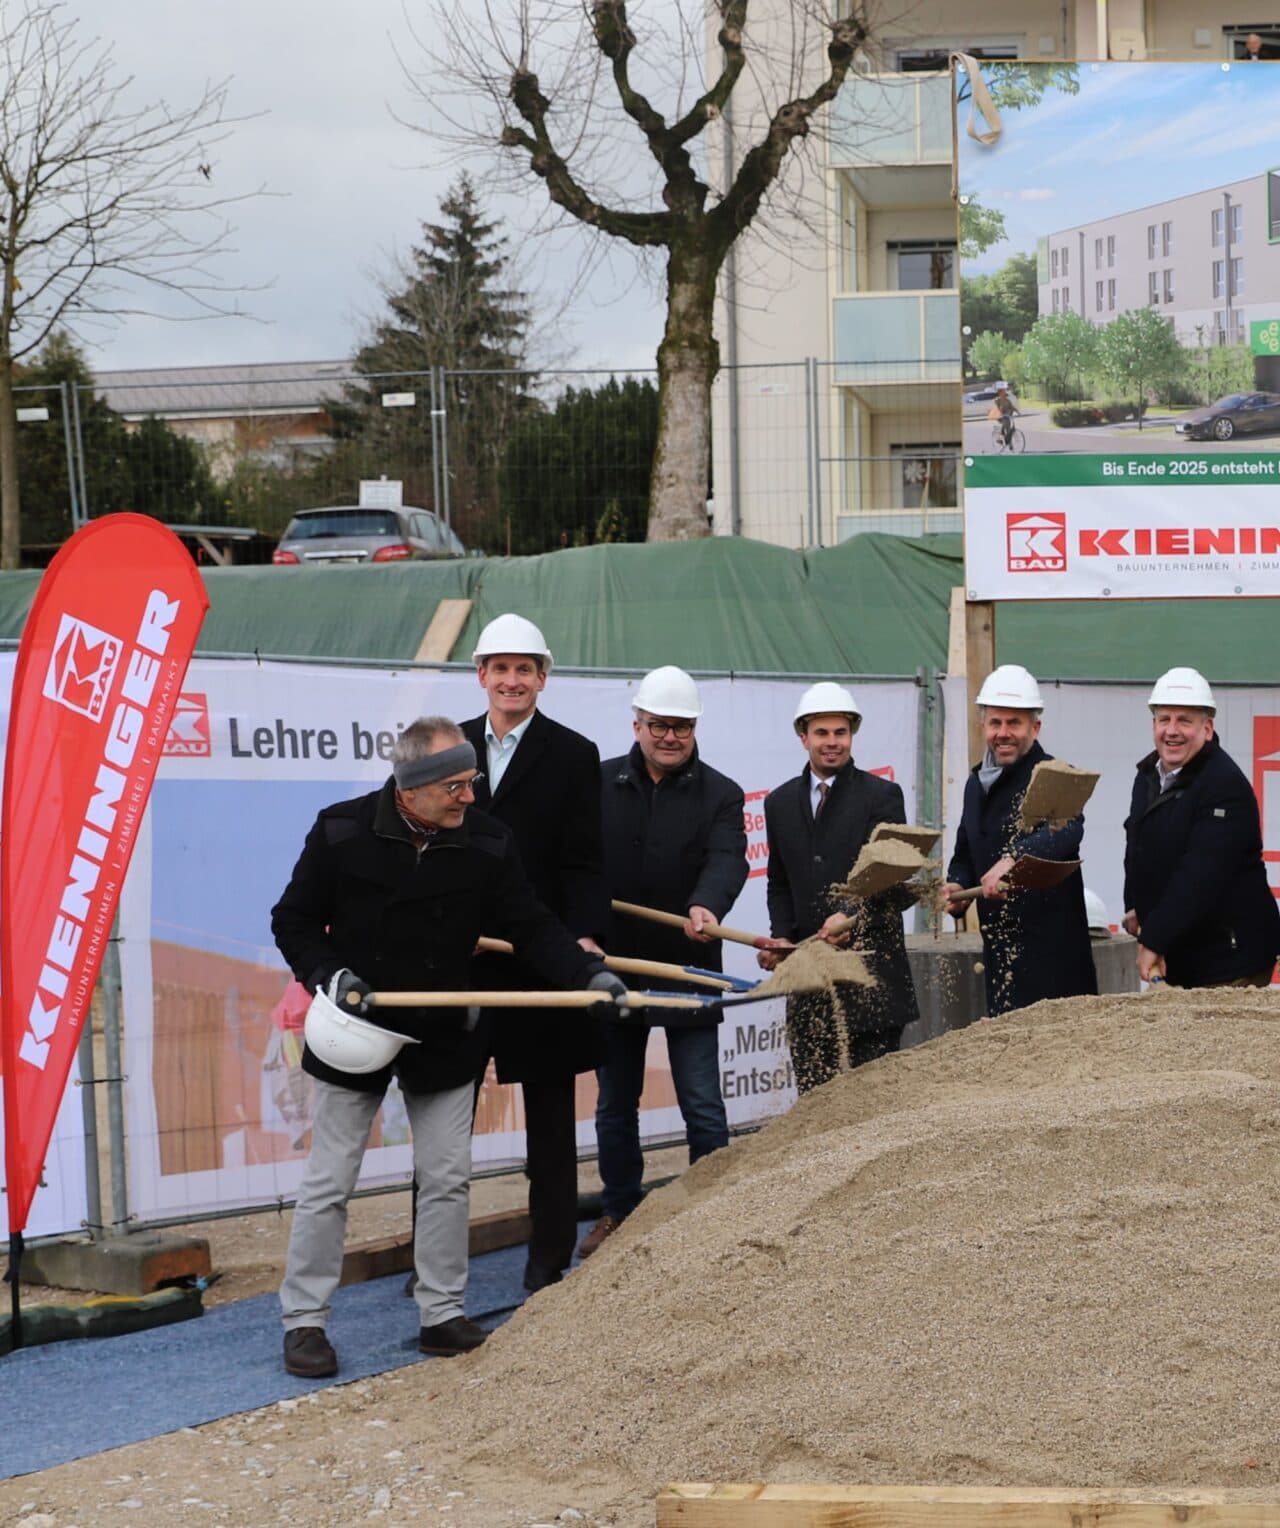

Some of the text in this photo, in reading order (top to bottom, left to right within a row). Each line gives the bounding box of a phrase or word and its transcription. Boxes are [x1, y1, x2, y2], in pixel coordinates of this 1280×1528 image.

[1102, 462, 1124, 476] Bis
[1127, 461, 1166, 475] Ende
[1168, 461, 1208, 475] 2025
[1211, 460, 1274, 475] entsteht
[1009, 559, 1064, 570] BAU
[1116, 562, 1230, 572] BAUUNTERNEHMEN
[228, 717, 339, 760] Lehre
[18, 588, 181, 1071] KIENINGER
[68, 660, 179, 1027] BAUUNTERNEHMEN ZIMMEREI BAUMARKT
